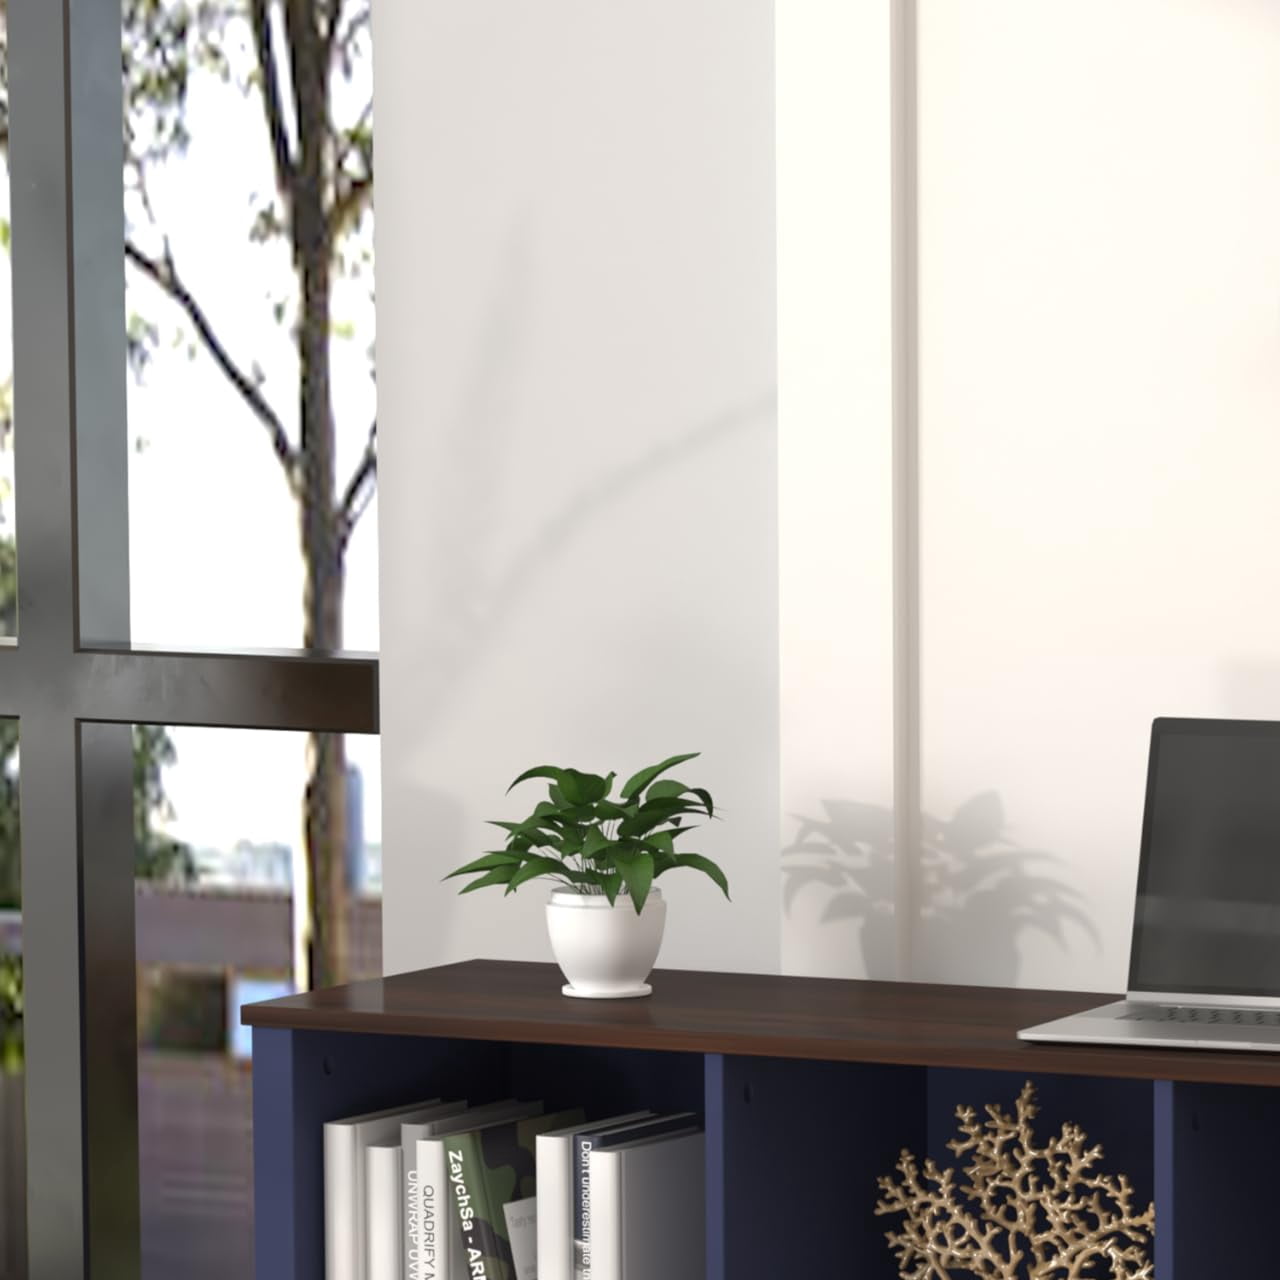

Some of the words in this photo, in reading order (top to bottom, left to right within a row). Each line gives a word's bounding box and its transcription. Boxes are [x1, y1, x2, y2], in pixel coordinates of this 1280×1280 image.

[408, 1170, 419, 1245] UNWRAP
[423, 1184, 436, 1269] QUADRIFY
[448, 1149, 474, 1232] ZaychSa
